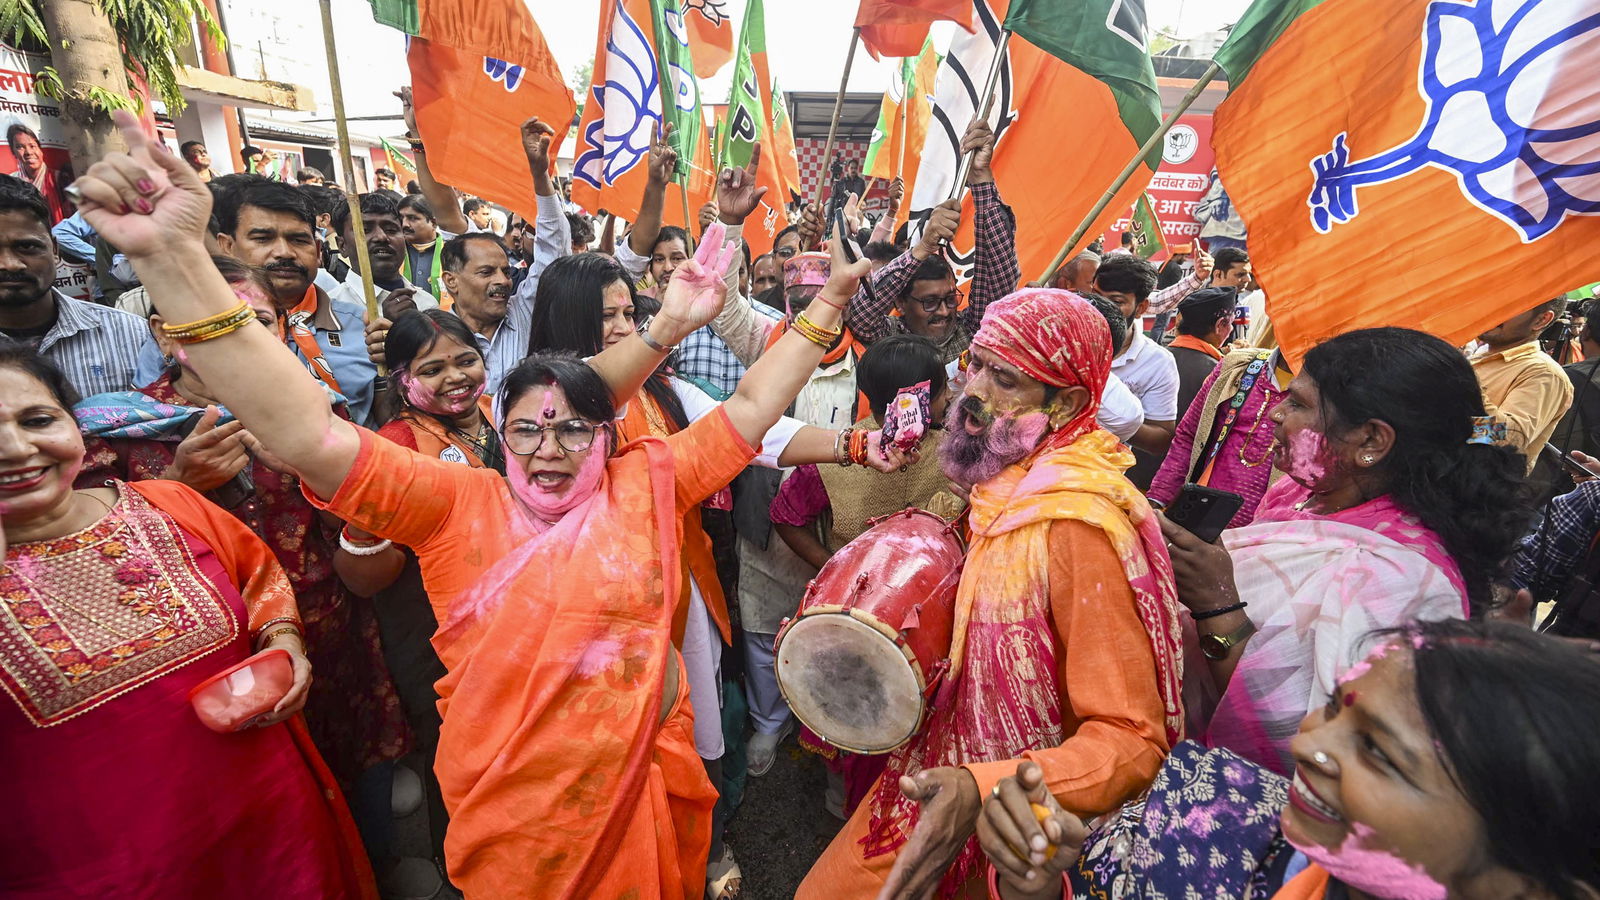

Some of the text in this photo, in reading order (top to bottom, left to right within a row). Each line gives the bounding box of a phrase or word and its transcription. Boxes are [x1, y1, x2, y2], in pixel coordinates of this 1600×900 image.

[1153, 174, 1204, 190] नवंबर को
[1158, 199, 1182, 215] आ
[1162, 220, 1203, 236] सरक
